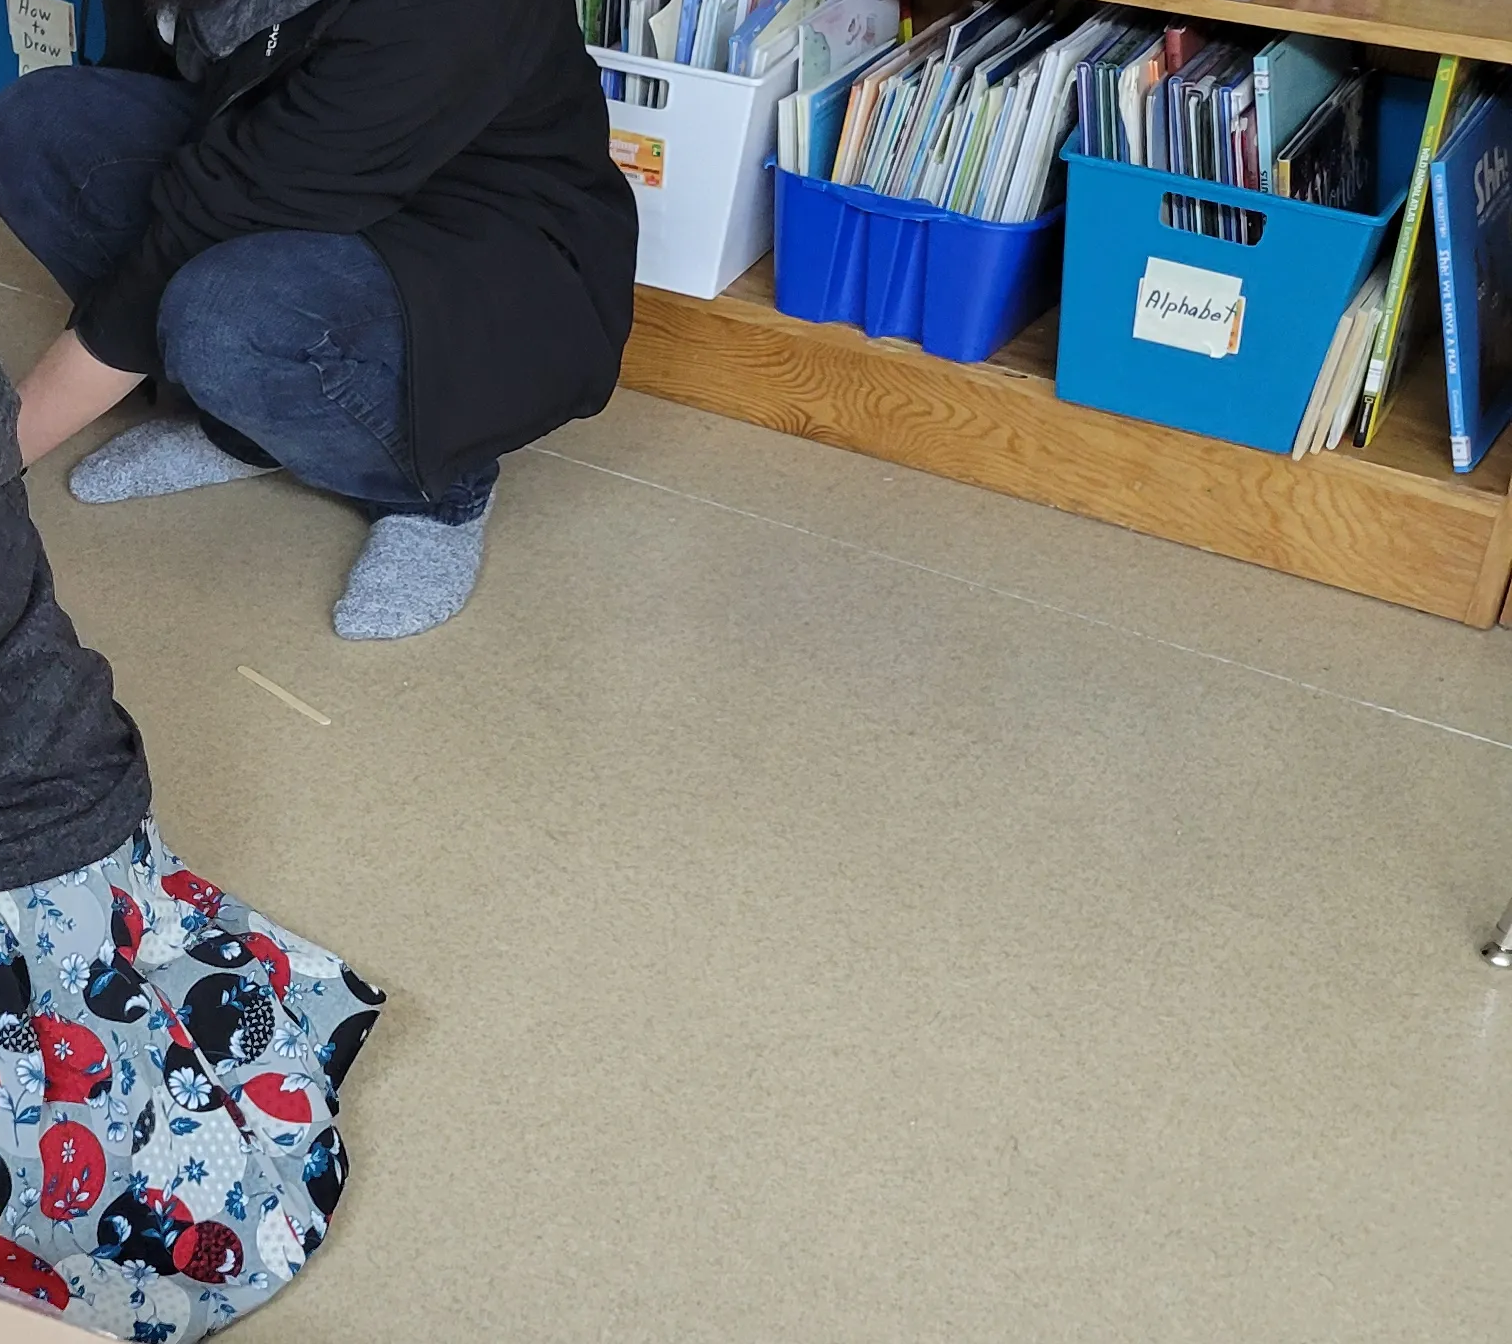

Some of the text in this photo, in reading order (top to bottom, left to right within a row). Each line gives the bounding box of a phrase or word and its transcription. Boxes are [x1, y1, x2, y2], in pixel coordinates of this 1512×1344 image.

[32, 21, 45, 35] to
[24, 32, 61, 57] Draw
[1418, 147, 1431, 168] WILD
[1145, 290, 1238, 325] Alphabet
